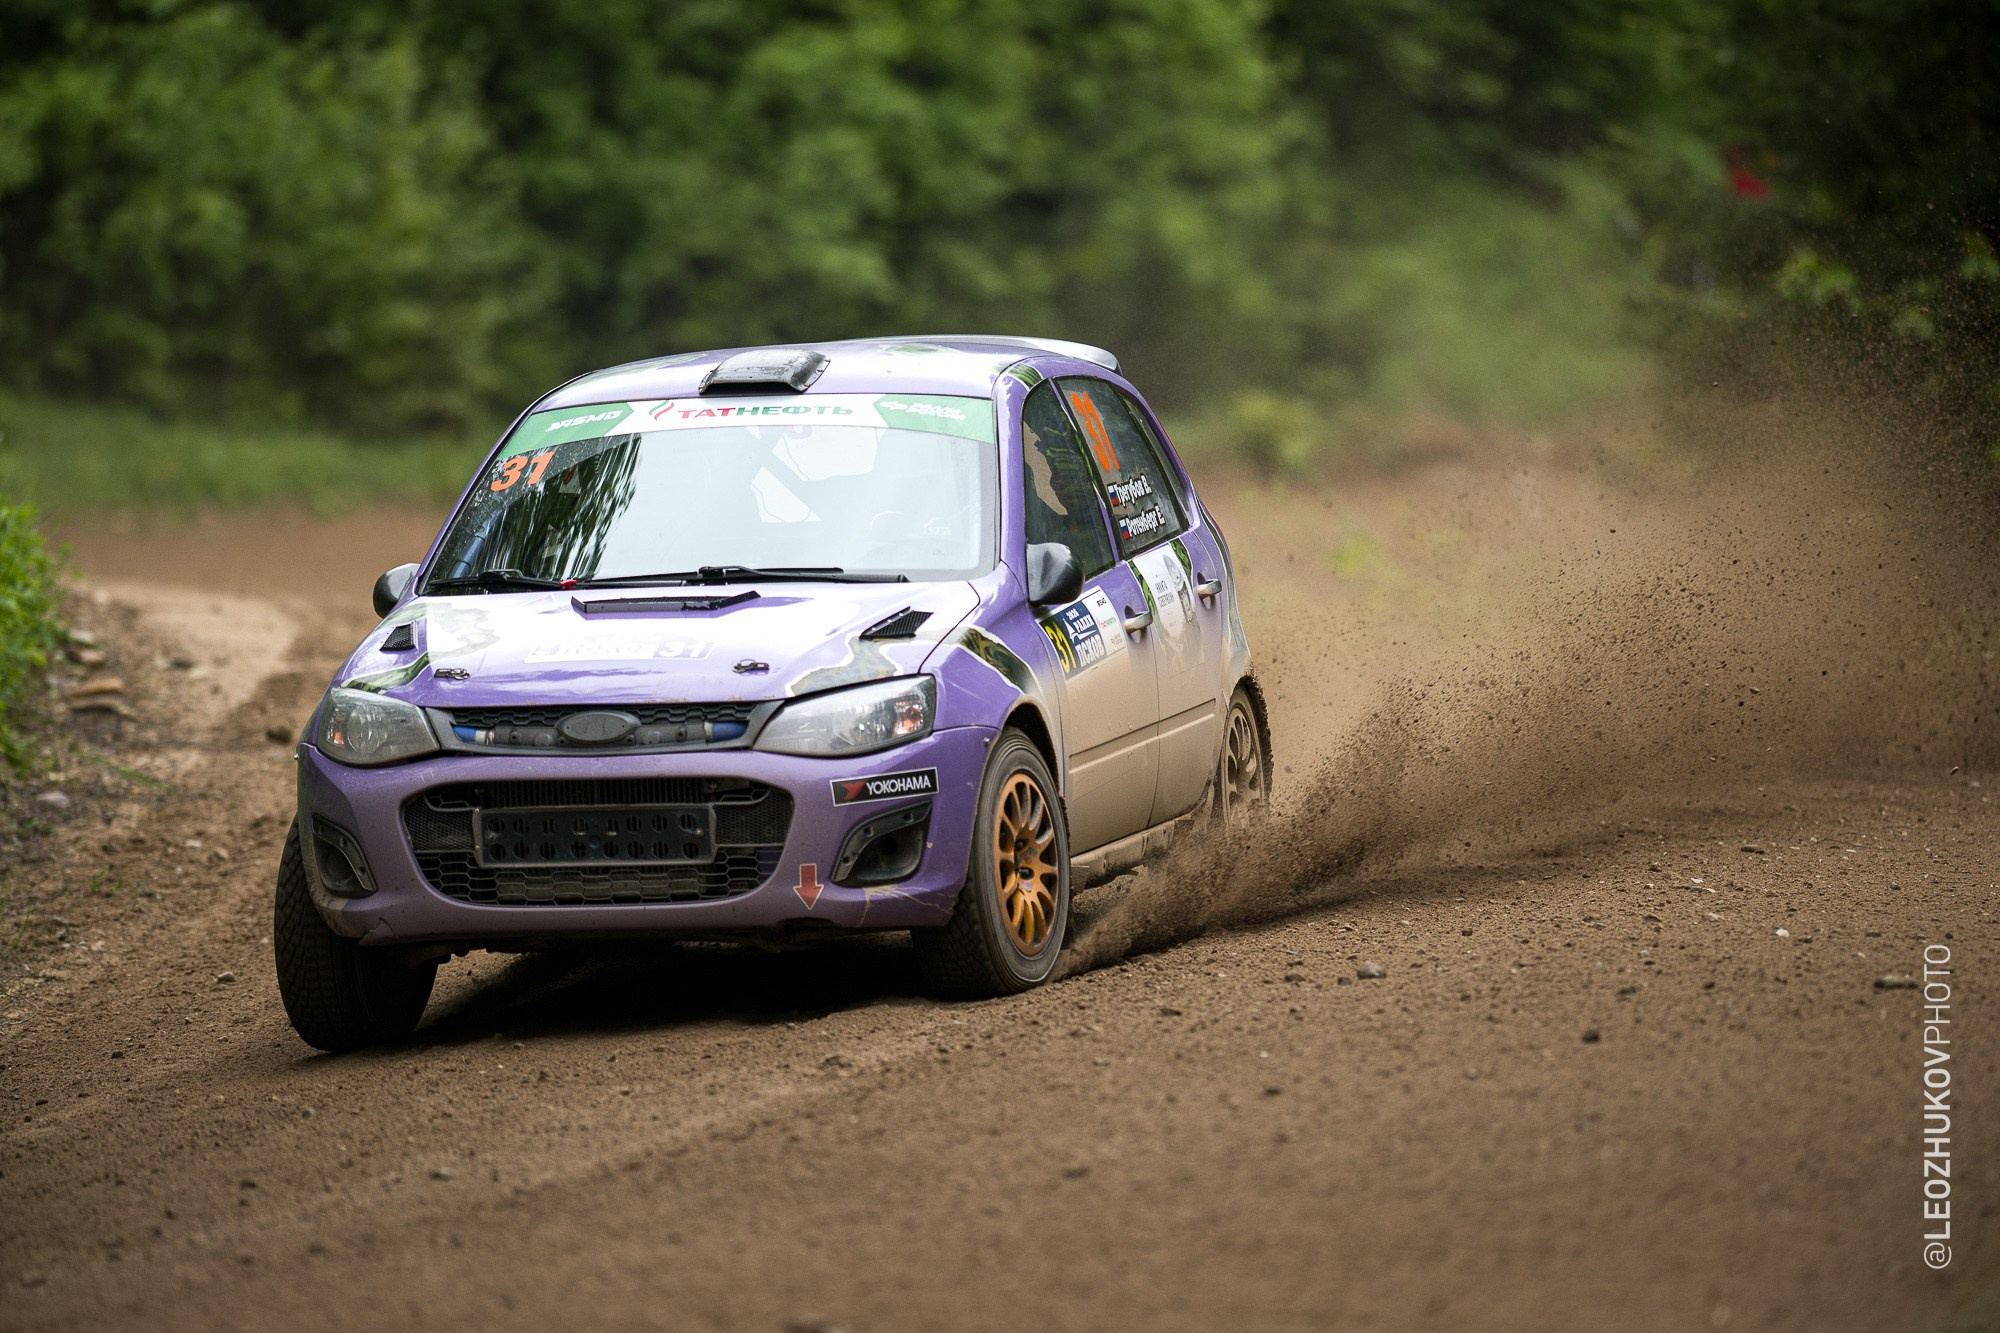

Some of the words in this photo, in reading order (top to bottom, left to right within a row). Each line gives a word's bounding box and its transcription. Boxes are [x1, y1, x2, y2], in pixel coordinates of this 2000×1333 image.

[678, 406, 853, 419] ТАТНЕФТЬ
[1072, 391, 1120, 472] 31
[490, 451, 555, 492] 31
[659, 641, 708, 658] 31
[1045, 621, 1077, 673] 31
[1075, 634, 1105, 667] ПСКОВ
[866, 775, 931, 795] YOKOHAMA
